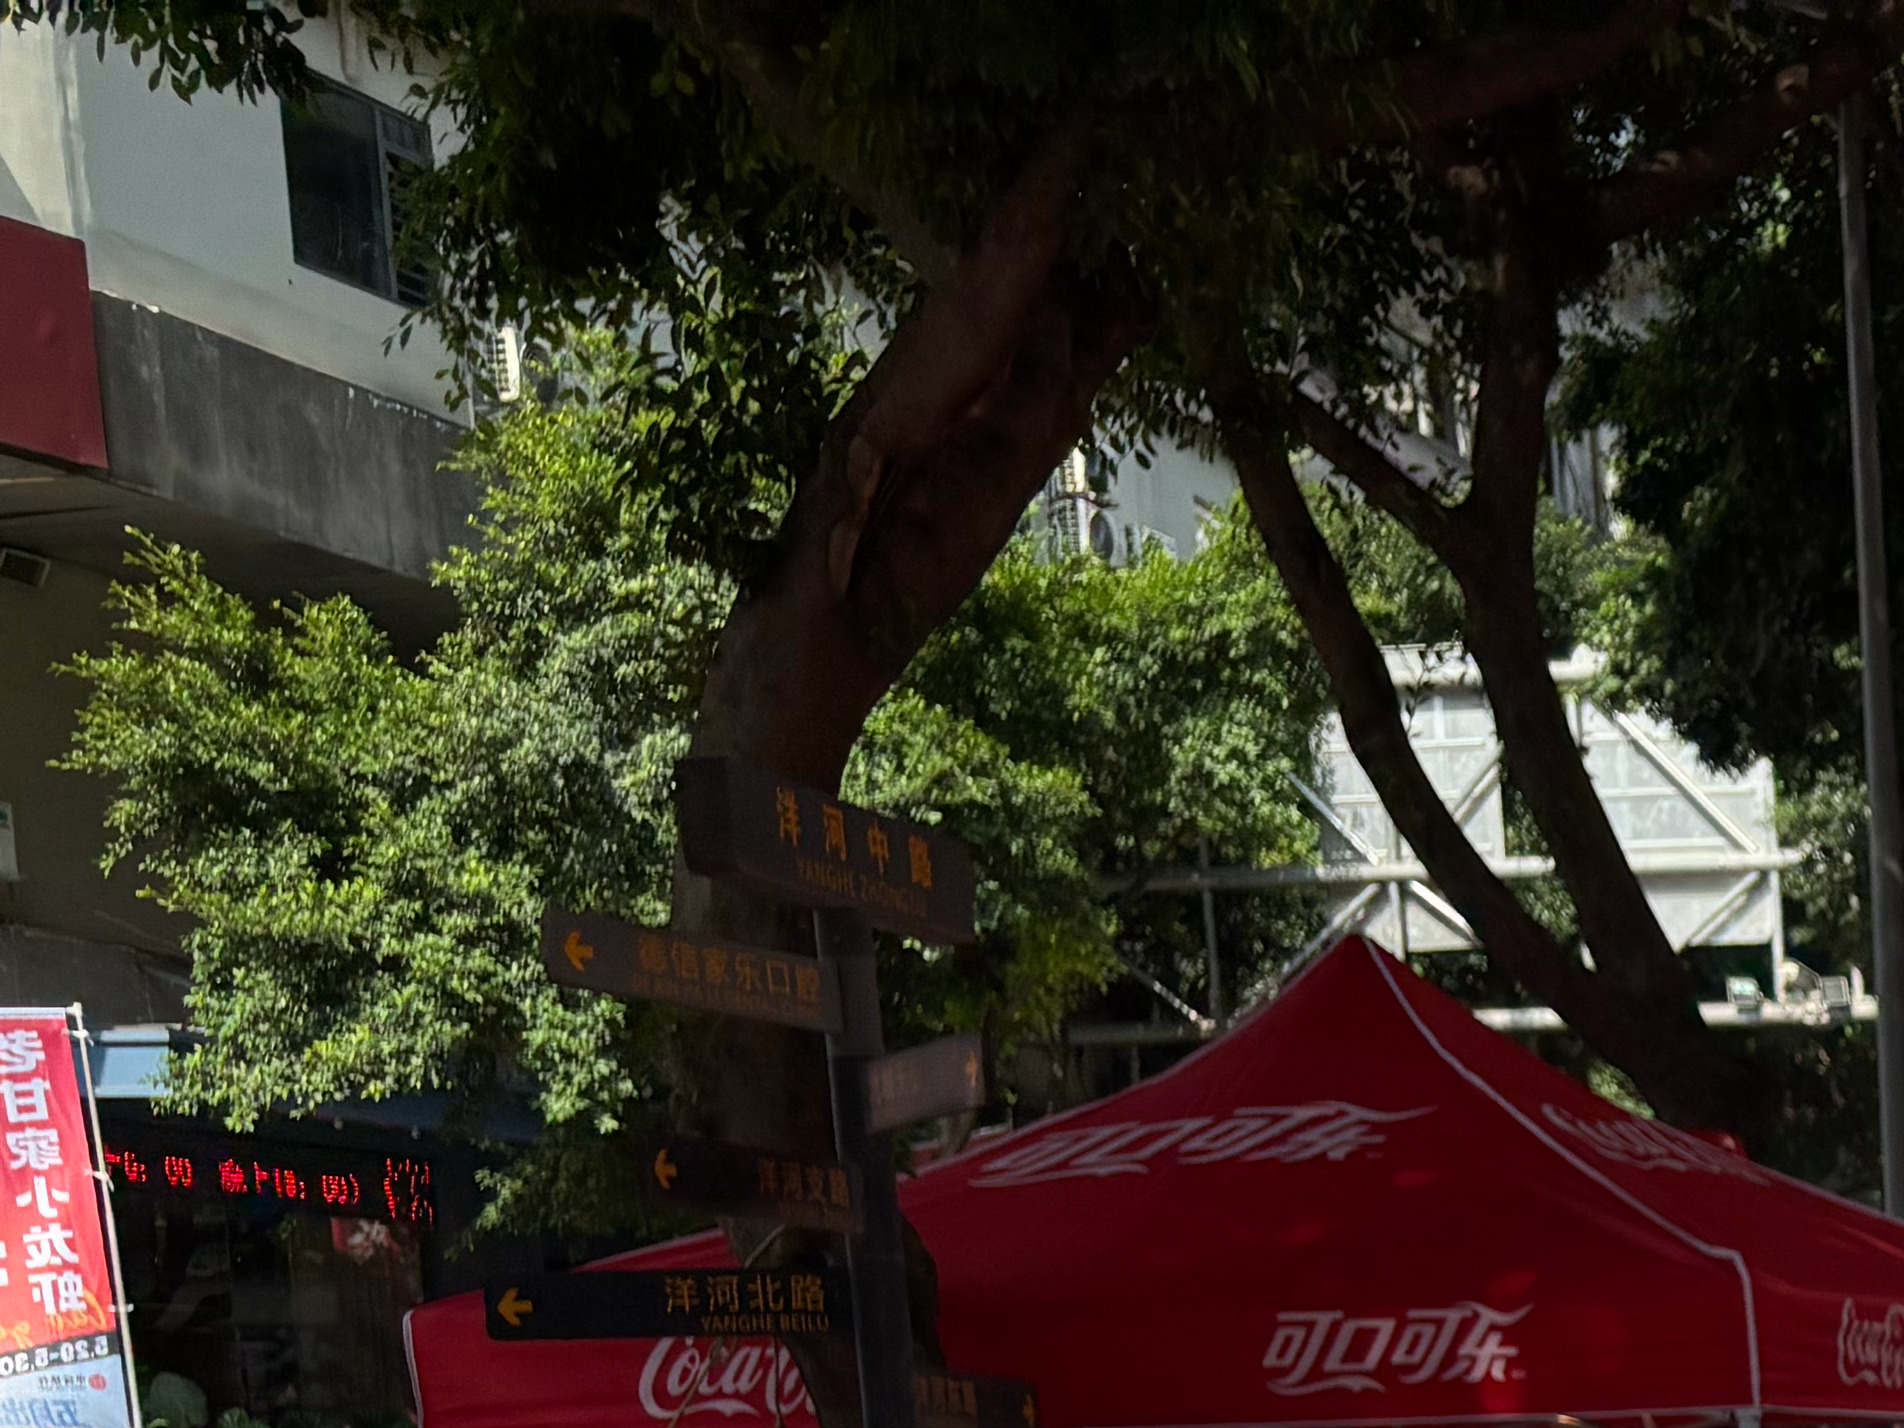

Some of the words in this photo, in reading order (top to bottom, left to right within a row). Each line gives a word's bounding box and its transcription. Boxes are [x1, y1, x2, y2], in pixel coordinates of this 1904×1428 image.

[775, 785, 934, 890] 洋河中路
[664, 1273, 827, 1315] 洋河北路
[701, 1314, 776, 1334] YANGHE
[779, 1314, 831, 1333] BEILU
[1261, 1299, 1536, 1397] 可口可乐
